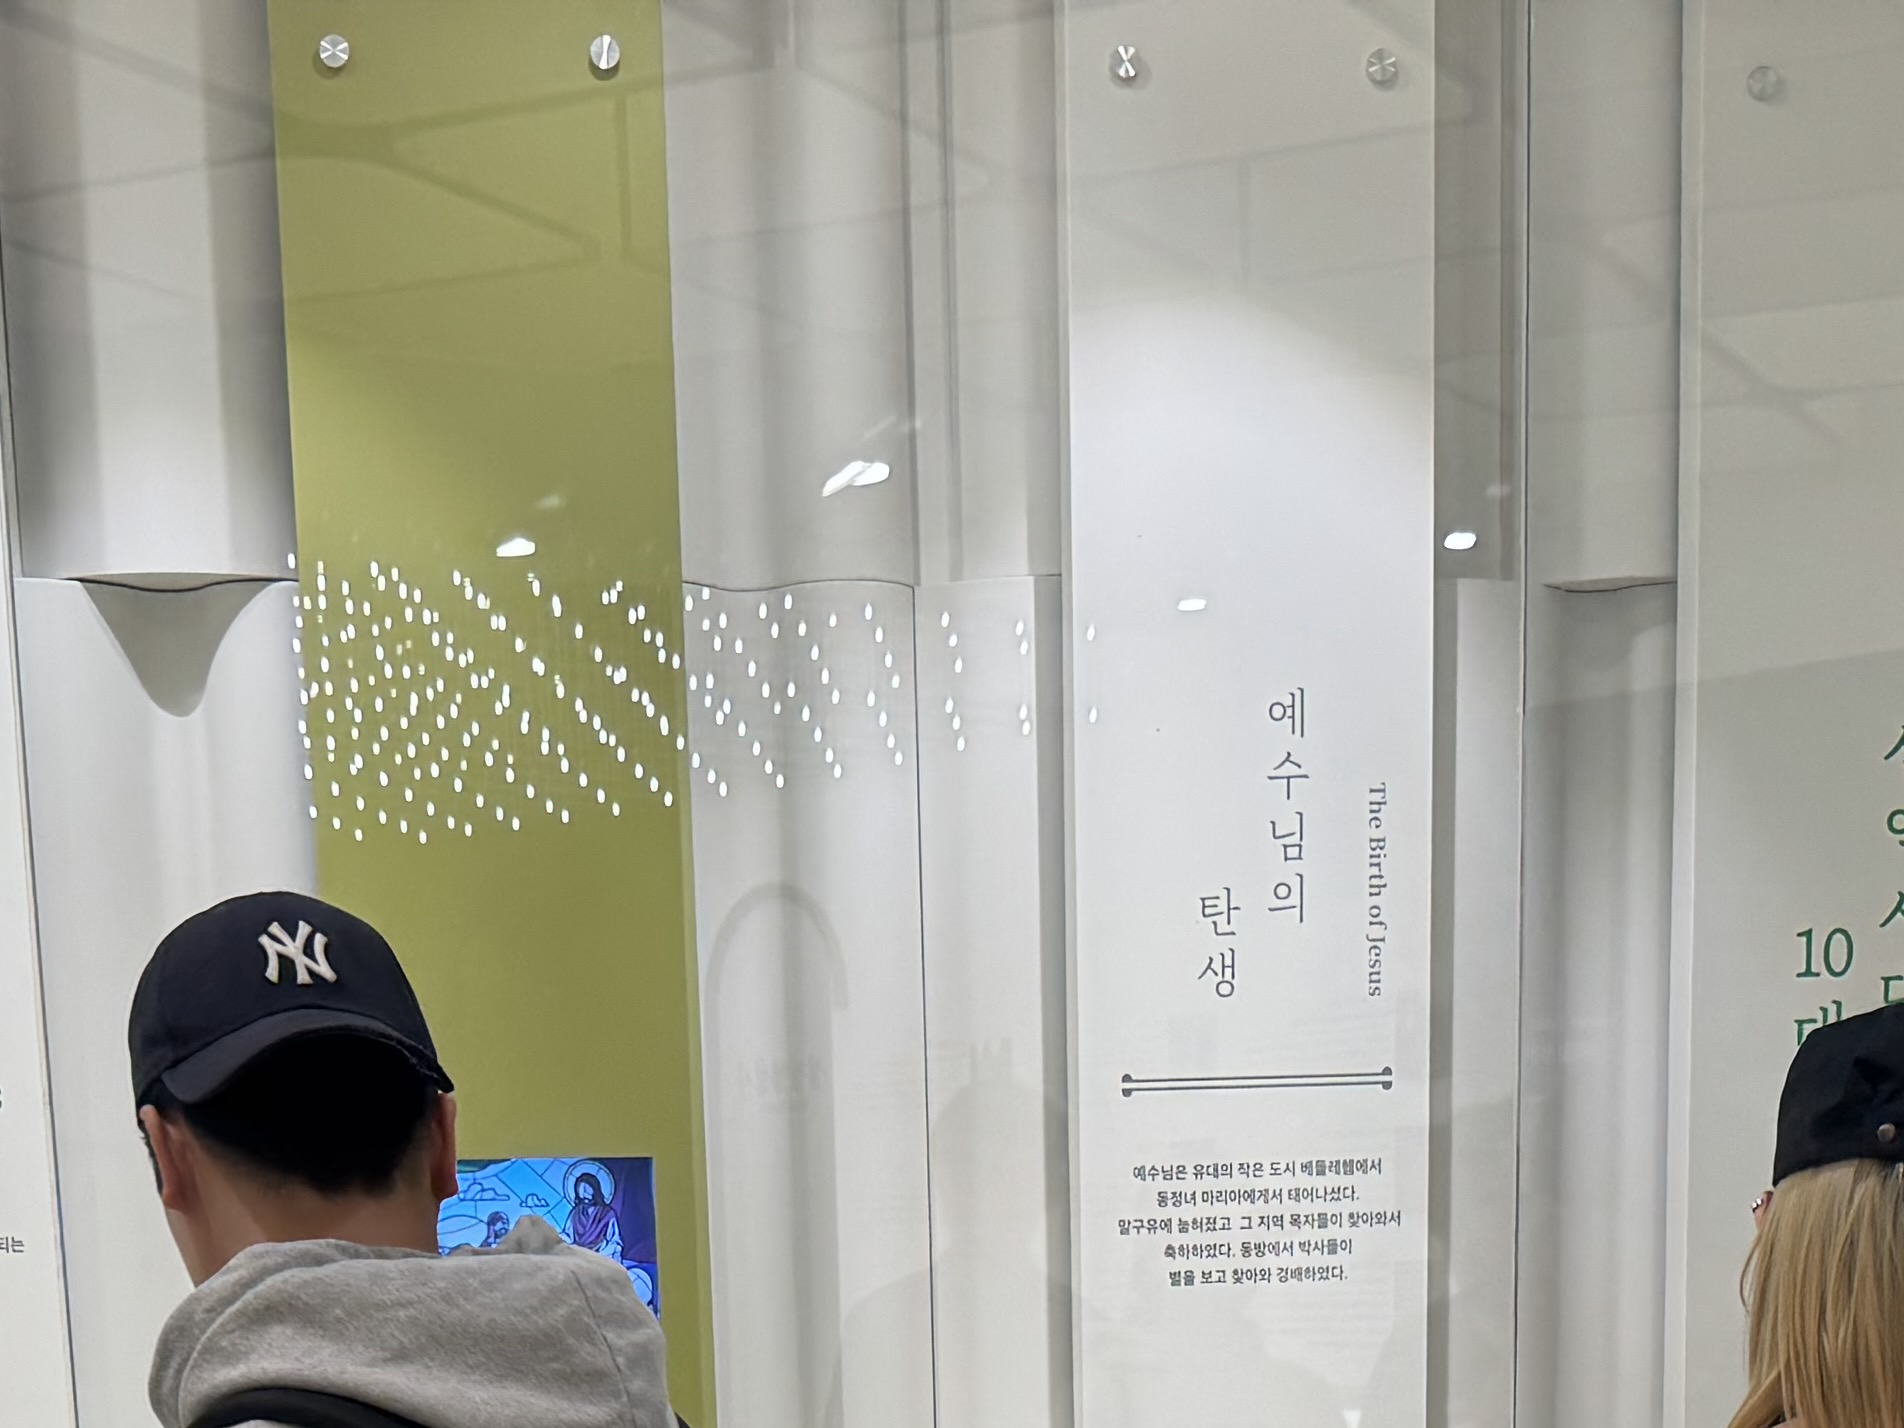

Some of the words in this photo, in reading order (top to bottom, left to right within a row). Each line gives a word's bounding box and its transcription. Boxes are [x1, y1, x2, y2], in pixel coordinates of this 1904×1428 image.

[1266, 686, 1310, 924] 예수님의
[1368, 781, 1388, 829] The
[1368, 836, 1388, 898] Birth
[1368, 904, 1388, 931] of
[258, 920, 337, 985] NY
[1197, 886, 1241, 998] 탄생
[1365, 933, 1386, 997] Jesus
[1132, 1164, 1188, 1182] 예수님은
[1192, 1162, 1233, 1181] 유대의
[1237, 1162, 1265, 1179] 작은
[1268, 1160, 1296, 1178] 도시
[1156, 1190, 1197, 1208] 동정녀
[1239, 1215, 1253, 1230] 그
[1257, 1213, 1284, 1232] 지역
[1347, 1209, 1401, 1228] 찾아와서
[1239, 1240, 1294, 1259] 동방에서
[1168, 1269, 1196, 1287] 별을
[1199, 1269, 1227, 1285] 보고
[1231, 1267, 1272, 1285] 찾아와
